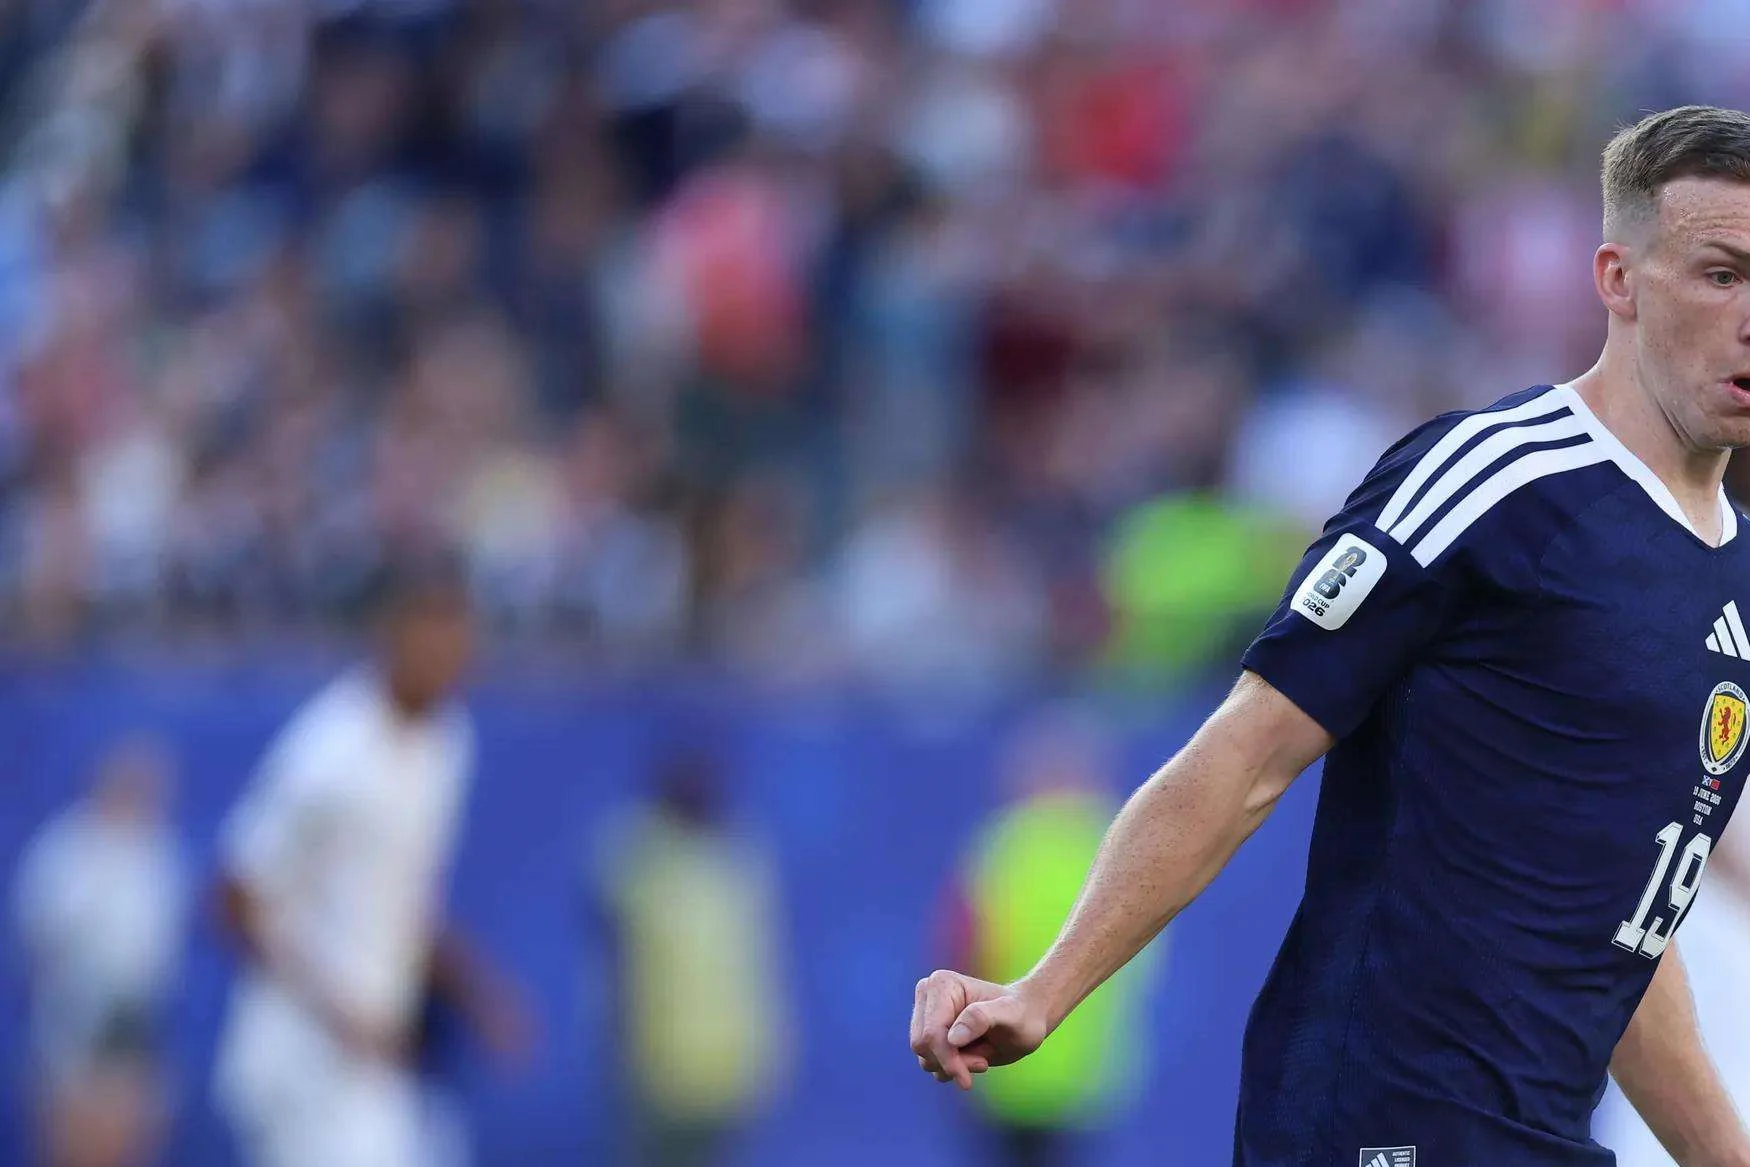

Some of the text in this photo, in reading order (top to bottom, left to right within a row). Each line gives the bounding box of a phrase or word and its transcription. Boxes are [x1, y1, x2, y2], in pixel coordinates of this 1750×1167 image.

[1302, 598, 1326, 617] 026
[1317, 598, 1330, 609] CUP
[1717, 683, 1744, 699] SCOTLAND
[1611, 821, 1712, 960] 19
